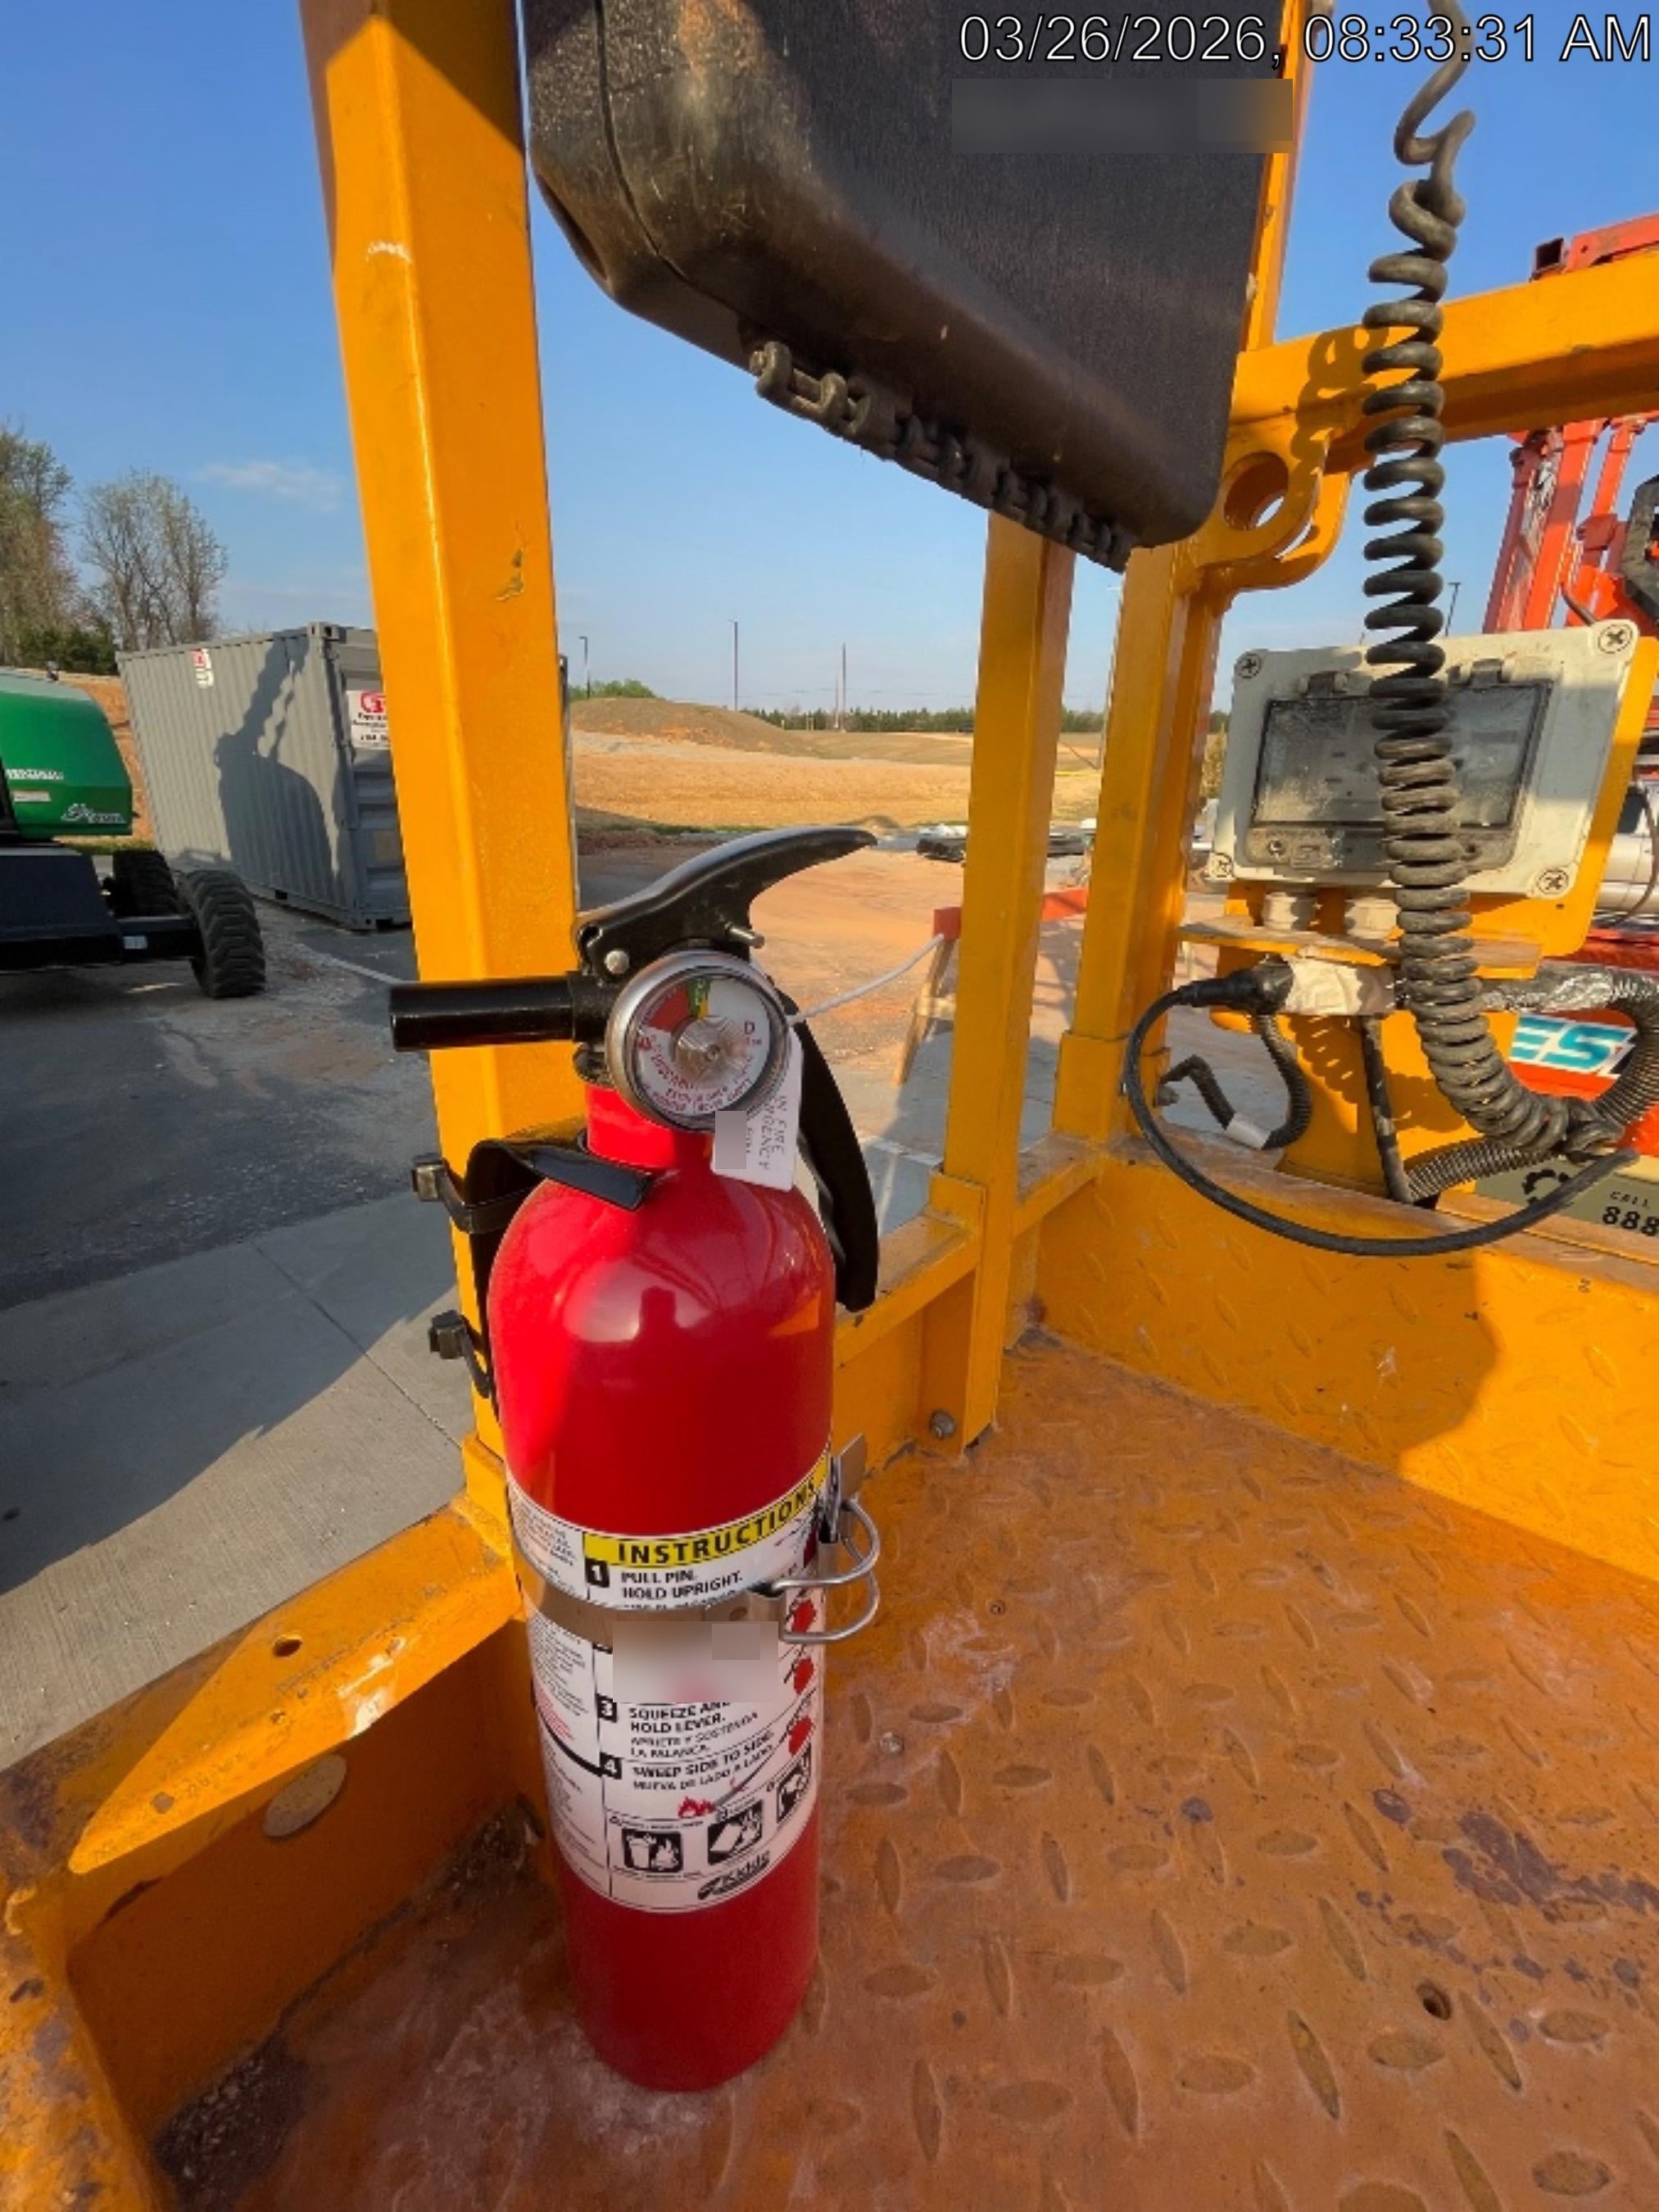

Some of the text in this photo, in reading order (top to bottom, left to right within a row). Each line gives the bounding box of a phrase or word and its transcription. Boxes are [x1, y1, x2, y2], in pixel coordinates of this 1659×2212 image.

[619, 1477, 814, 1564] INSTRUCTIONS
[621, 1571, 660, 1584] PULL
[623, 1569, 743, 1599] HOLD UPRIGHT.
[628, 1706, 696, 1720] SQUEEZE
[631, 1713, 726, 1734] HOLD LEVER.
[633, 1766, 682, 1778] SWEEP
[685, 1759, 718, 1775] SIDE
[723, 1751, 741, 1763] TO
